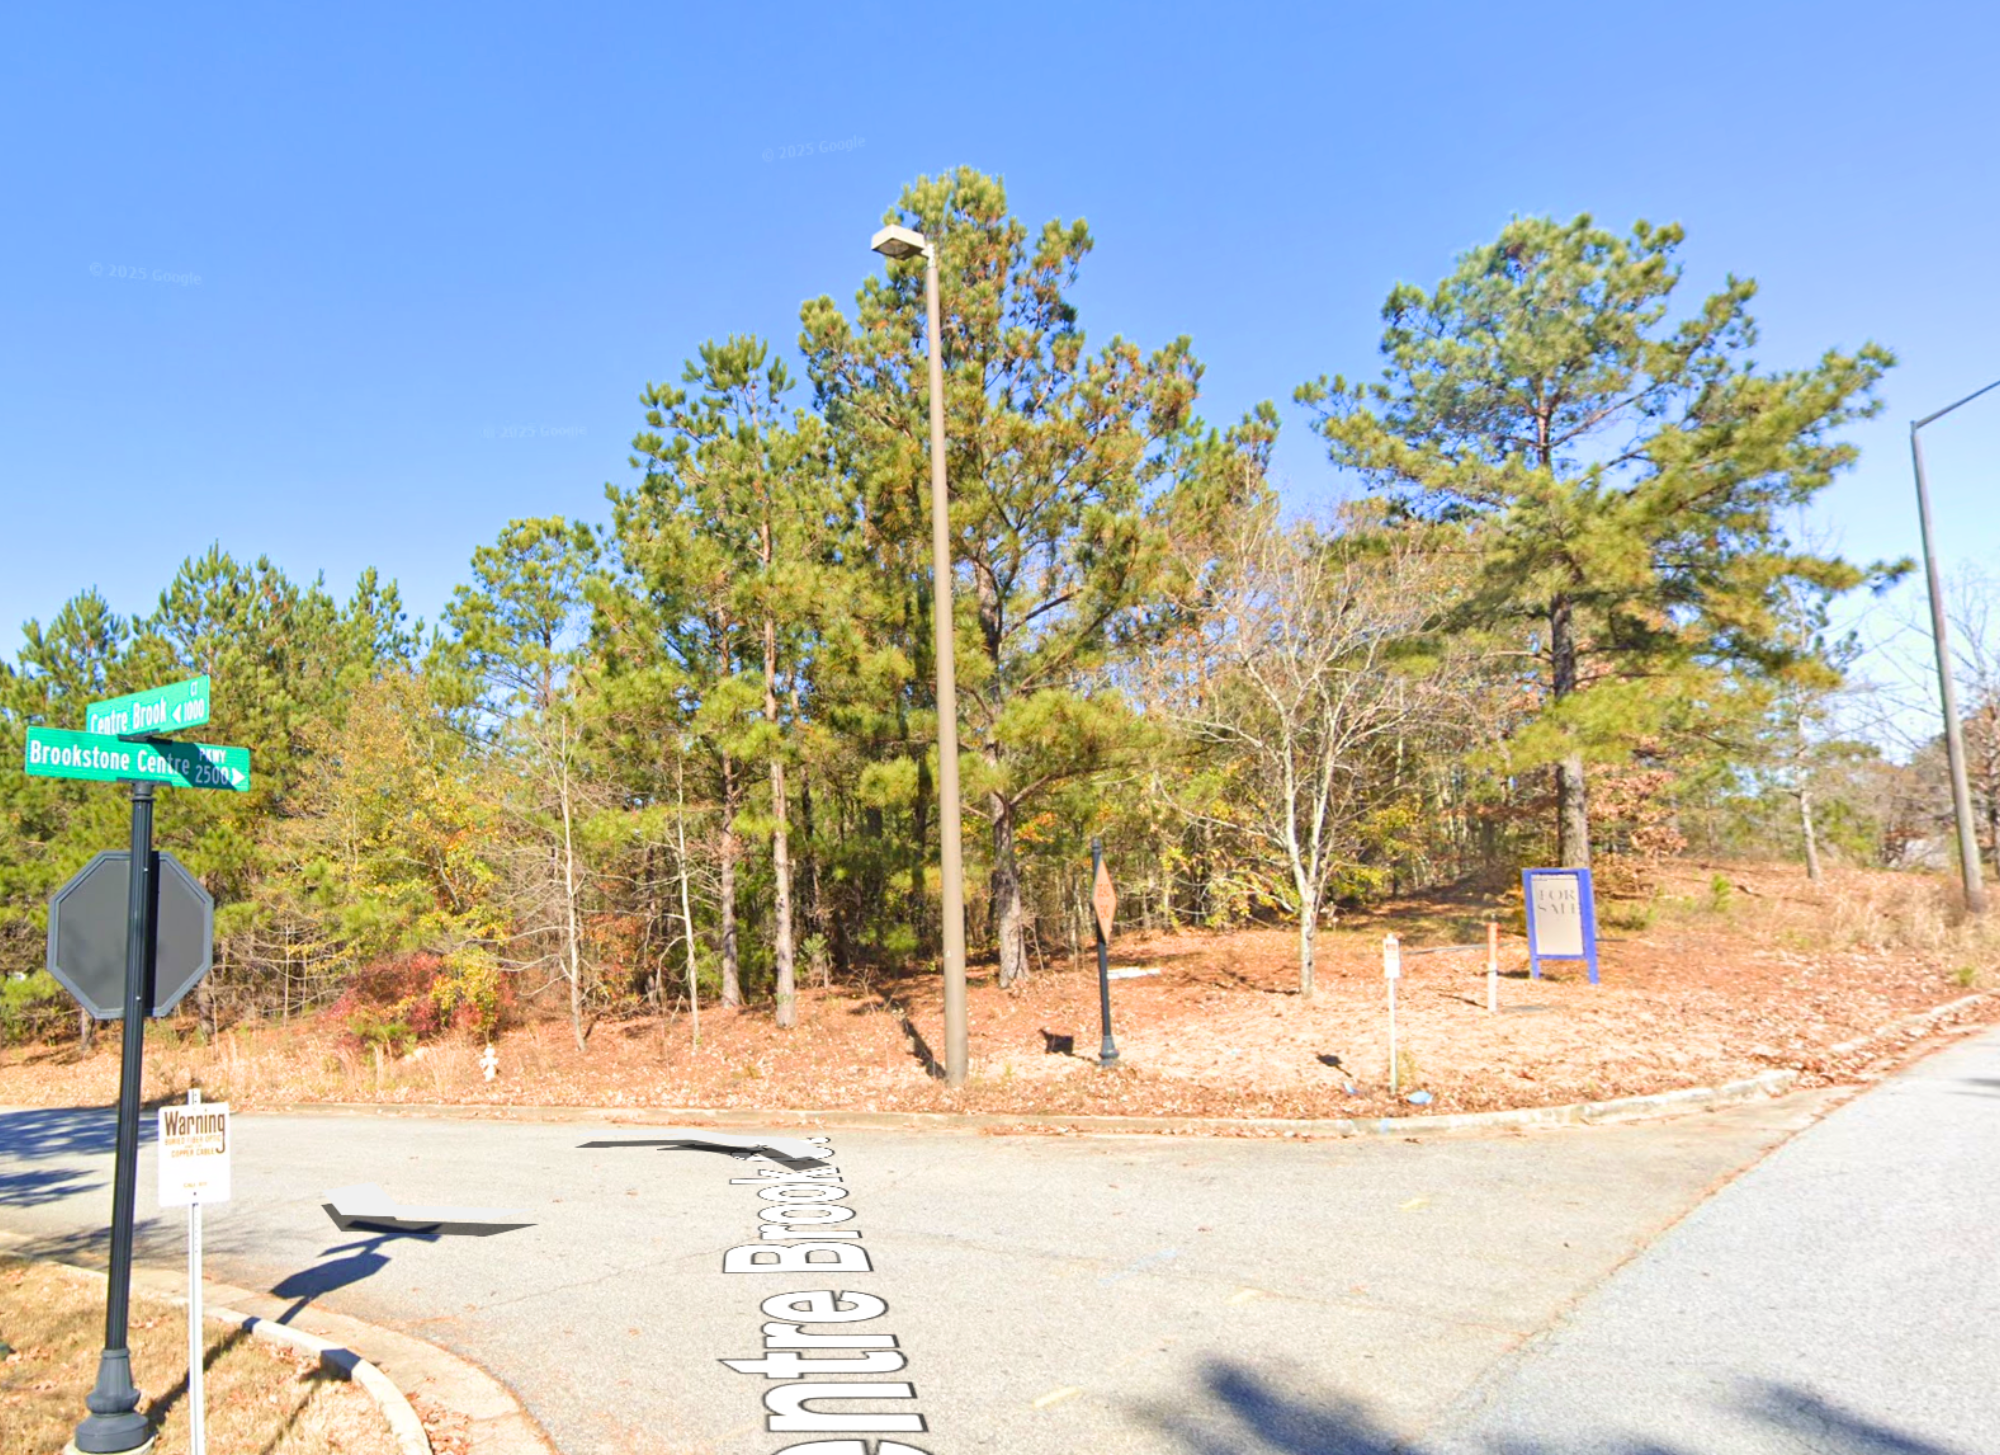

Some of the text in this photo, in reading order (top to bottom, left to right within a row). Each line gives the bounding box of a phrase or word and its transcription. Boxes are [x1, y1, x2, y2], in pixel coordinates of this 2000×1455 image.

[90, 696, 205, 735] Centre Brook 1000
[30, 740, 230, 785] Brookstone Centre 2500
[199, 748, 227, 763] PKWY
[164, 1110, 226, 1154] Warning
[171, 1147, 214, 1158] COPPER CABLE
